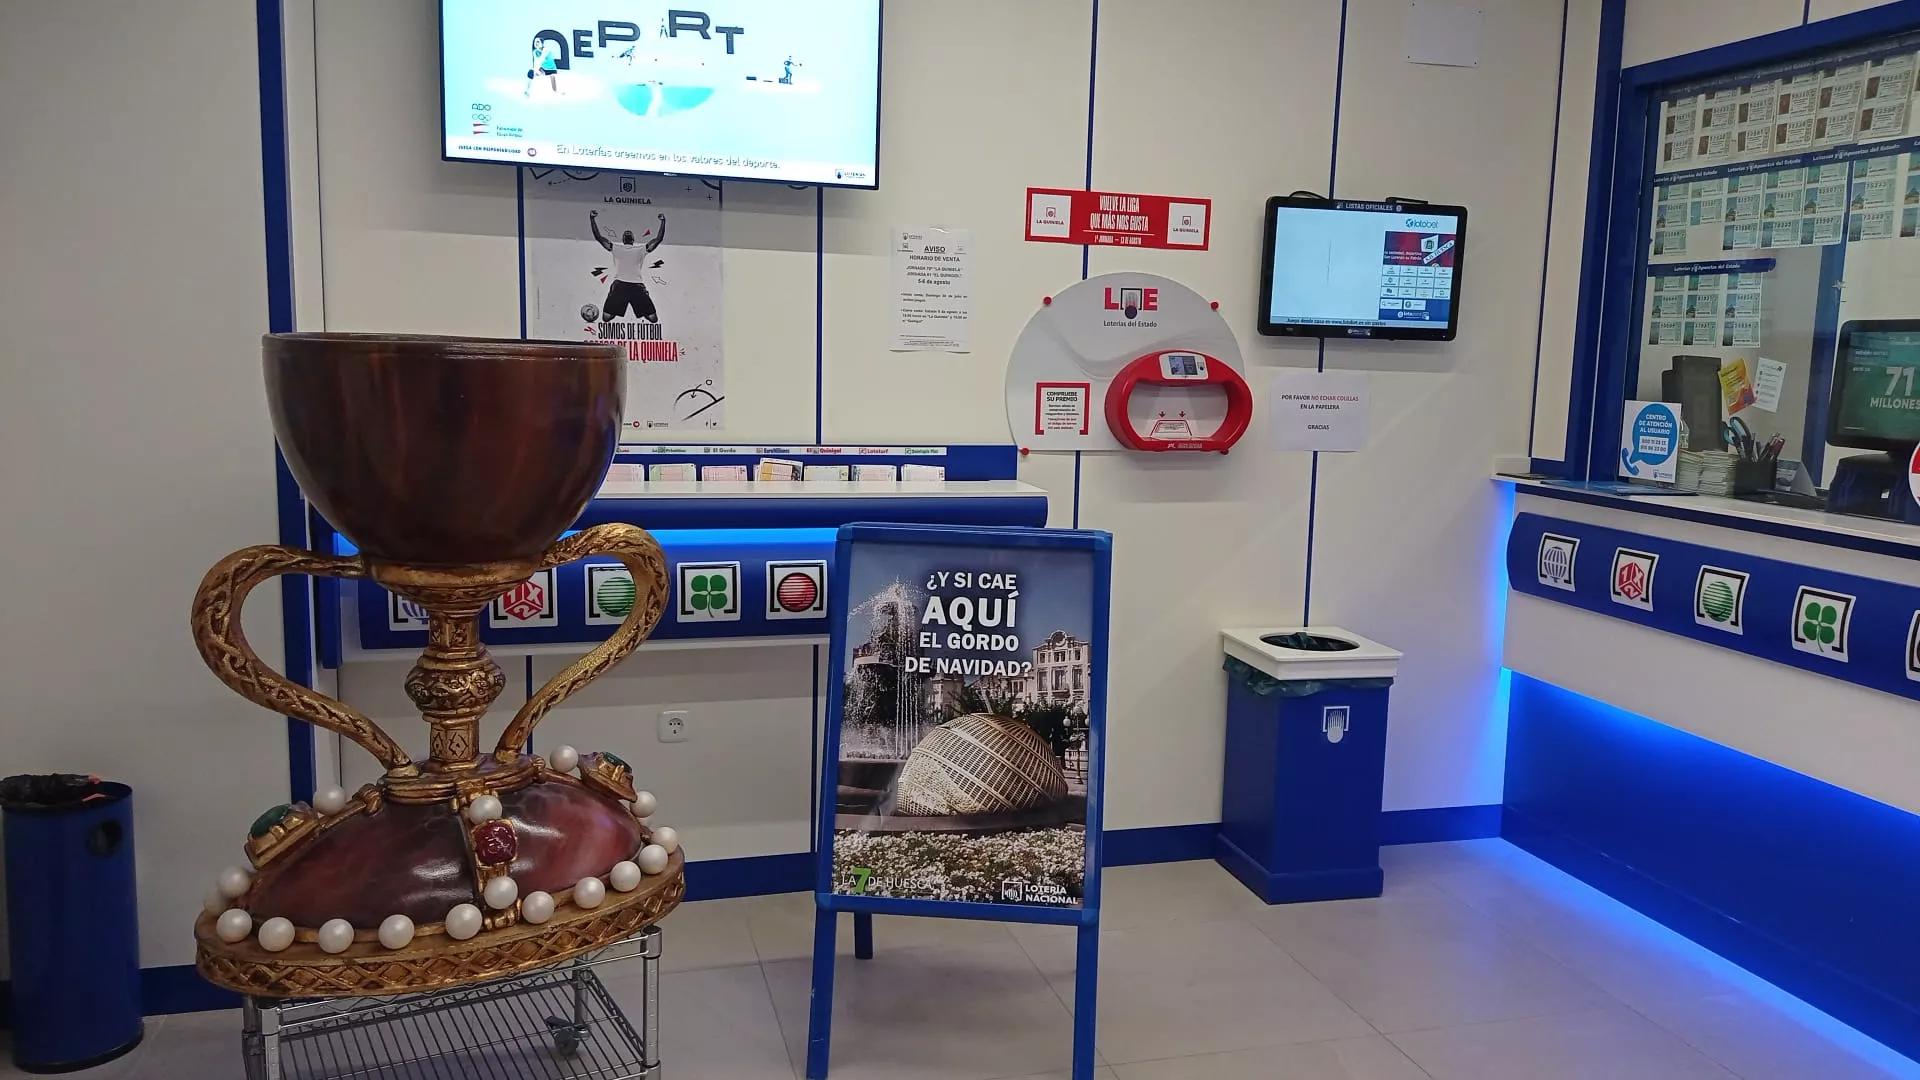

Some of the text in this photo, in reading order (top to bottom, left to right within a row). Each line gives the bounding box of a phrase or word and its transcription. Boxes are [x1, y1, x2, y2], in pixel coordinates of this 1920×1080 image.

[557, 144, 781, 169] En Loterías creemos en los valores del deporte.
[615, 197, 652, 205] QUINIELA
[1099, 195, 1140, 213] VUELVE LA LIGA
[1090, 211, 1149, 232] QUE MÁS NOS GUSTA
[924, 245, 945, 253] AVISO
[598, 319, 663, 341] SOMOS DE FÚTBOL
[1137, 320, 1158, 328] Estado
[629, 341, 678, 363] LA QUINIELA
[1885, 366, 1916, 397] 71
[1869, 397, 1920, 410] MILLONES
[1645, 413, 1667, 421] CENTRO
[1646, 420, 1673, 428] ATENCIÓN
[1647, 427, 1670, 435] USUARIO
[926, 571, 1017, 591] ¿Y SI CAE
[921, 591, 1019, 631] AQUÍ
[919, 631, 1019, 652] EL GORDO
[905, 656, 1032, 677] DE NAVIDAD?
[841, 867, 933, 894] LA 7 DE HUESCA
[1025, 884, 1067, 895] LOTERÍA
[1025, 895, 1079, 905] NACIONAL
